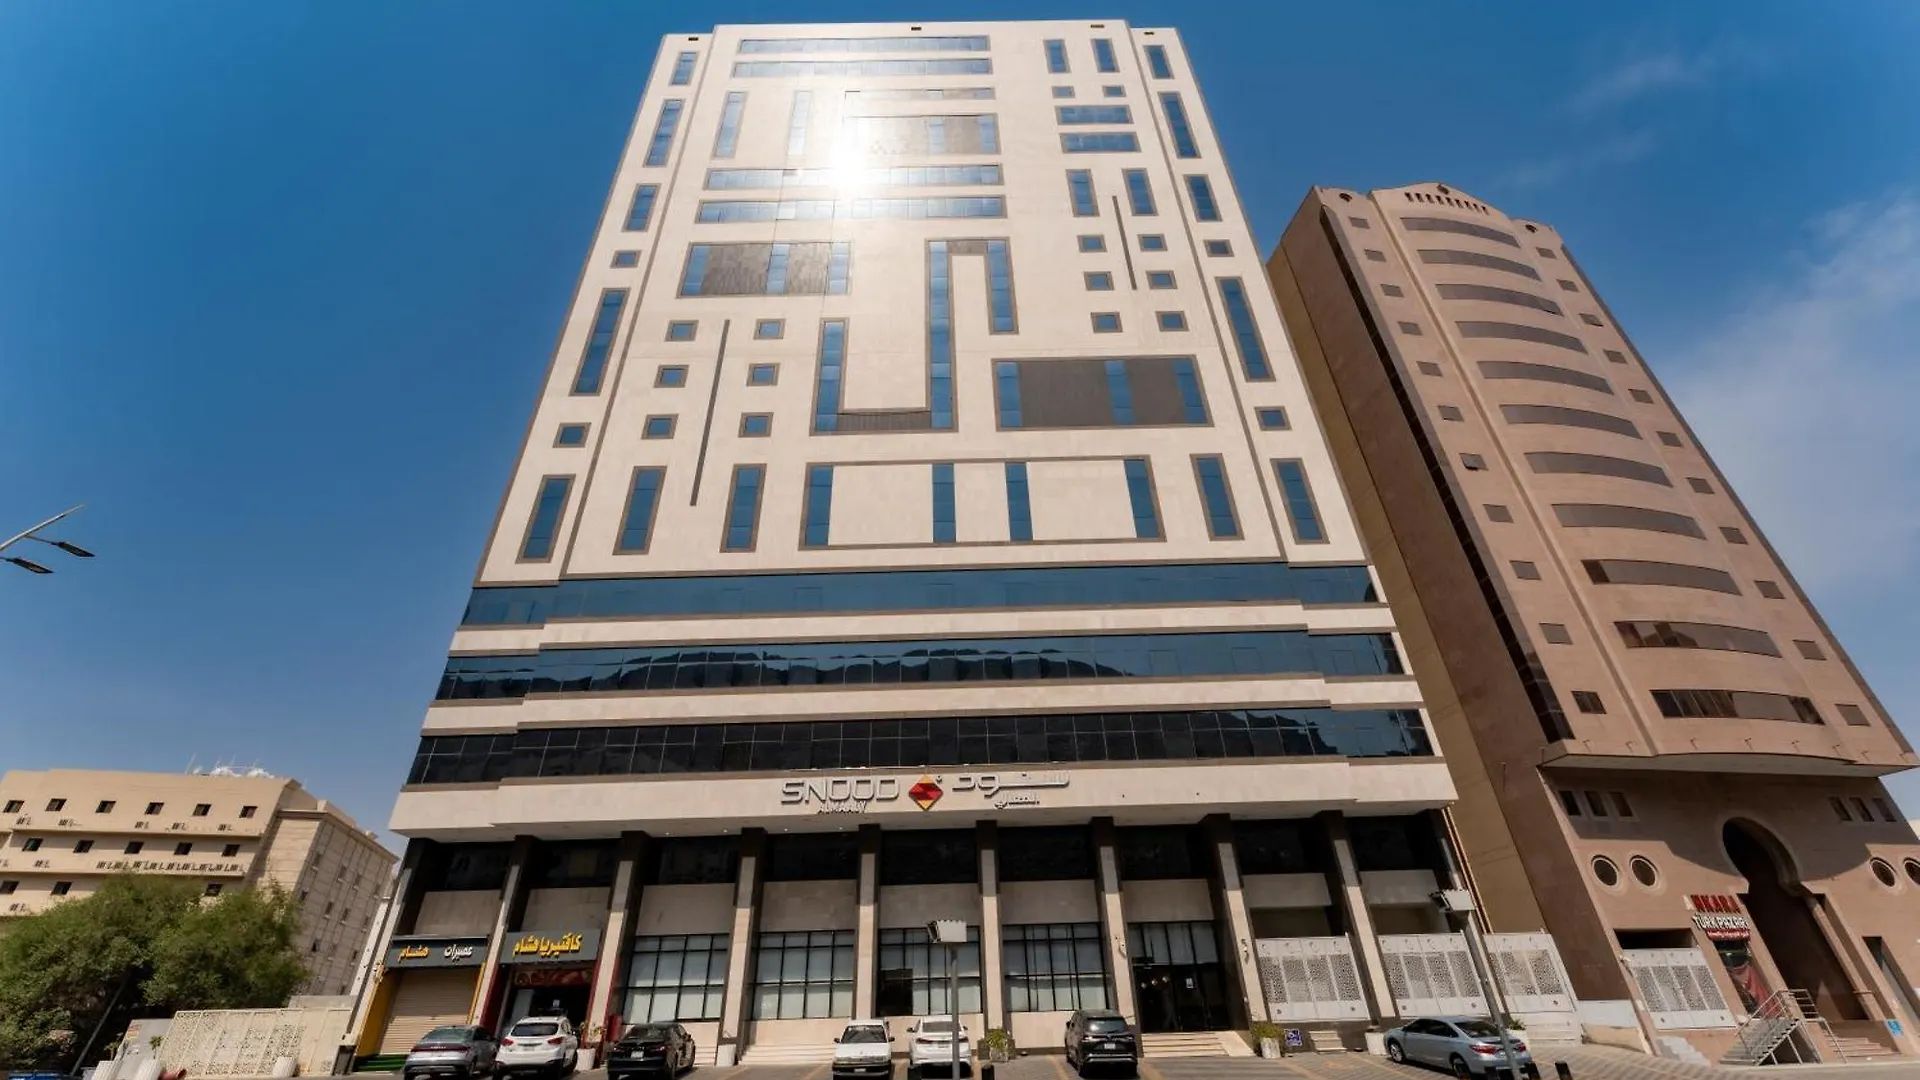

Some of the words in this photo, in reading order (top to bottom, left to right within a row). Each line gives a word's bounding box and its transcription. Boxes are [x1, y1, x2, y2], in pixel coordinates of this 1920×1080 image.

[781, 775, 900, 805] SNOOD
[397, 944, 430, 964] هشام
[512, 935, 539, 960] هشام
[539, 932, 583, 957] كافتيريا
